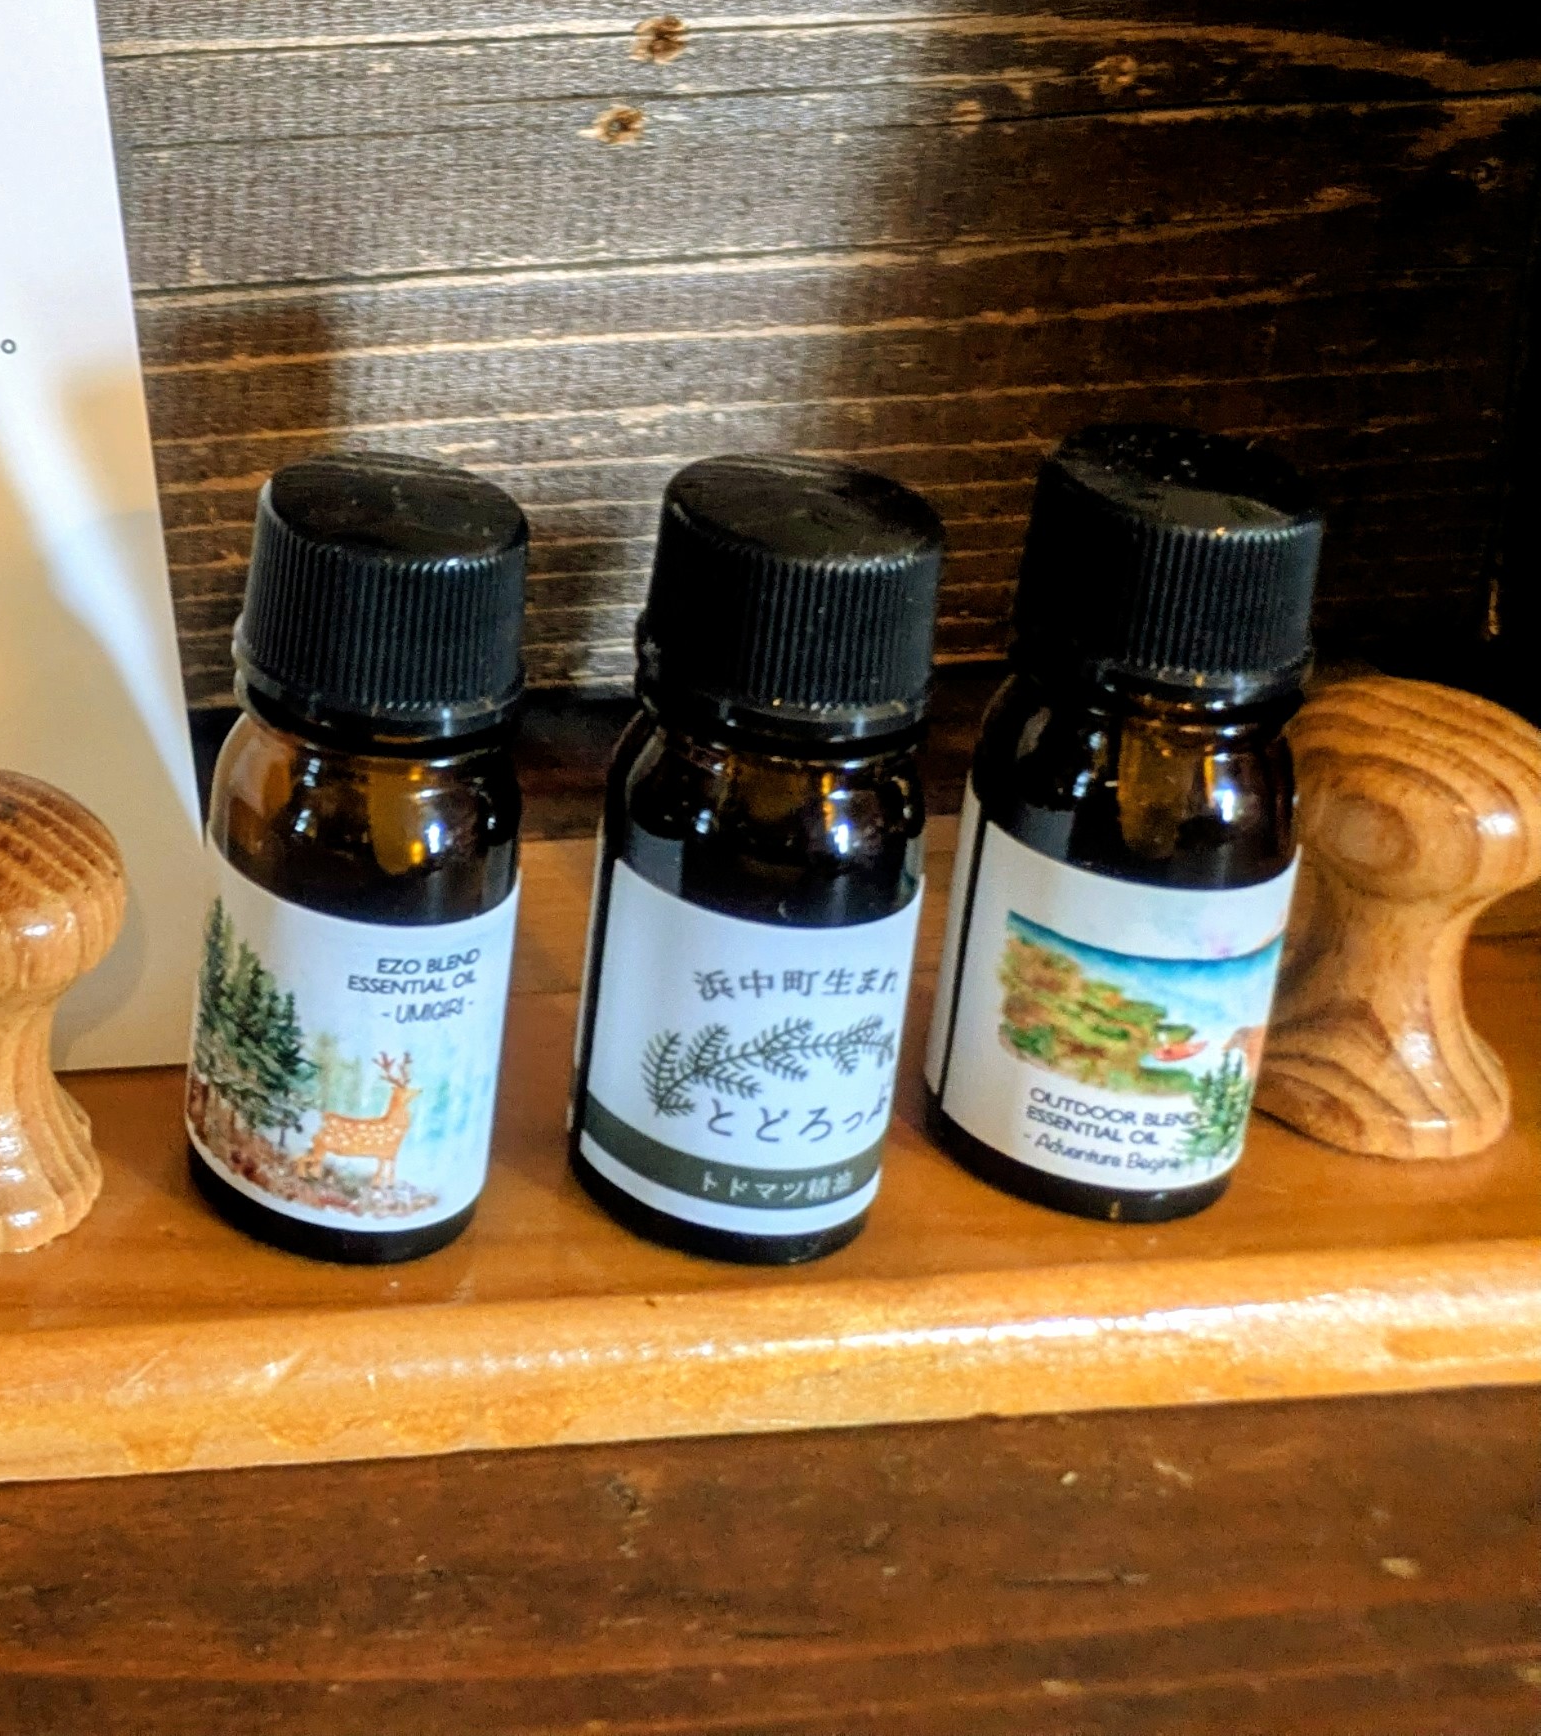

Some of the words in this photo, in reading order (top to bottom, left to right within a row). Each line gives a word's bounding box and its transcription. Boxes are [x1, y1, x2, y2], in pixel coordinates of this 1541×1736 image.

[377, 956, 422, 975] EZO
[427, 948, 481, 974] BLEND
[347, 974, 447, 995] ESSENTIAL
[452, 969, 477, 989] OIL
[1025, 1104, 1123, 1144] ESSENTIAL
[1029, 1087, 1136, 1125] OUTDOOR
[1034, 1132, 1121, 1168] Adventure
